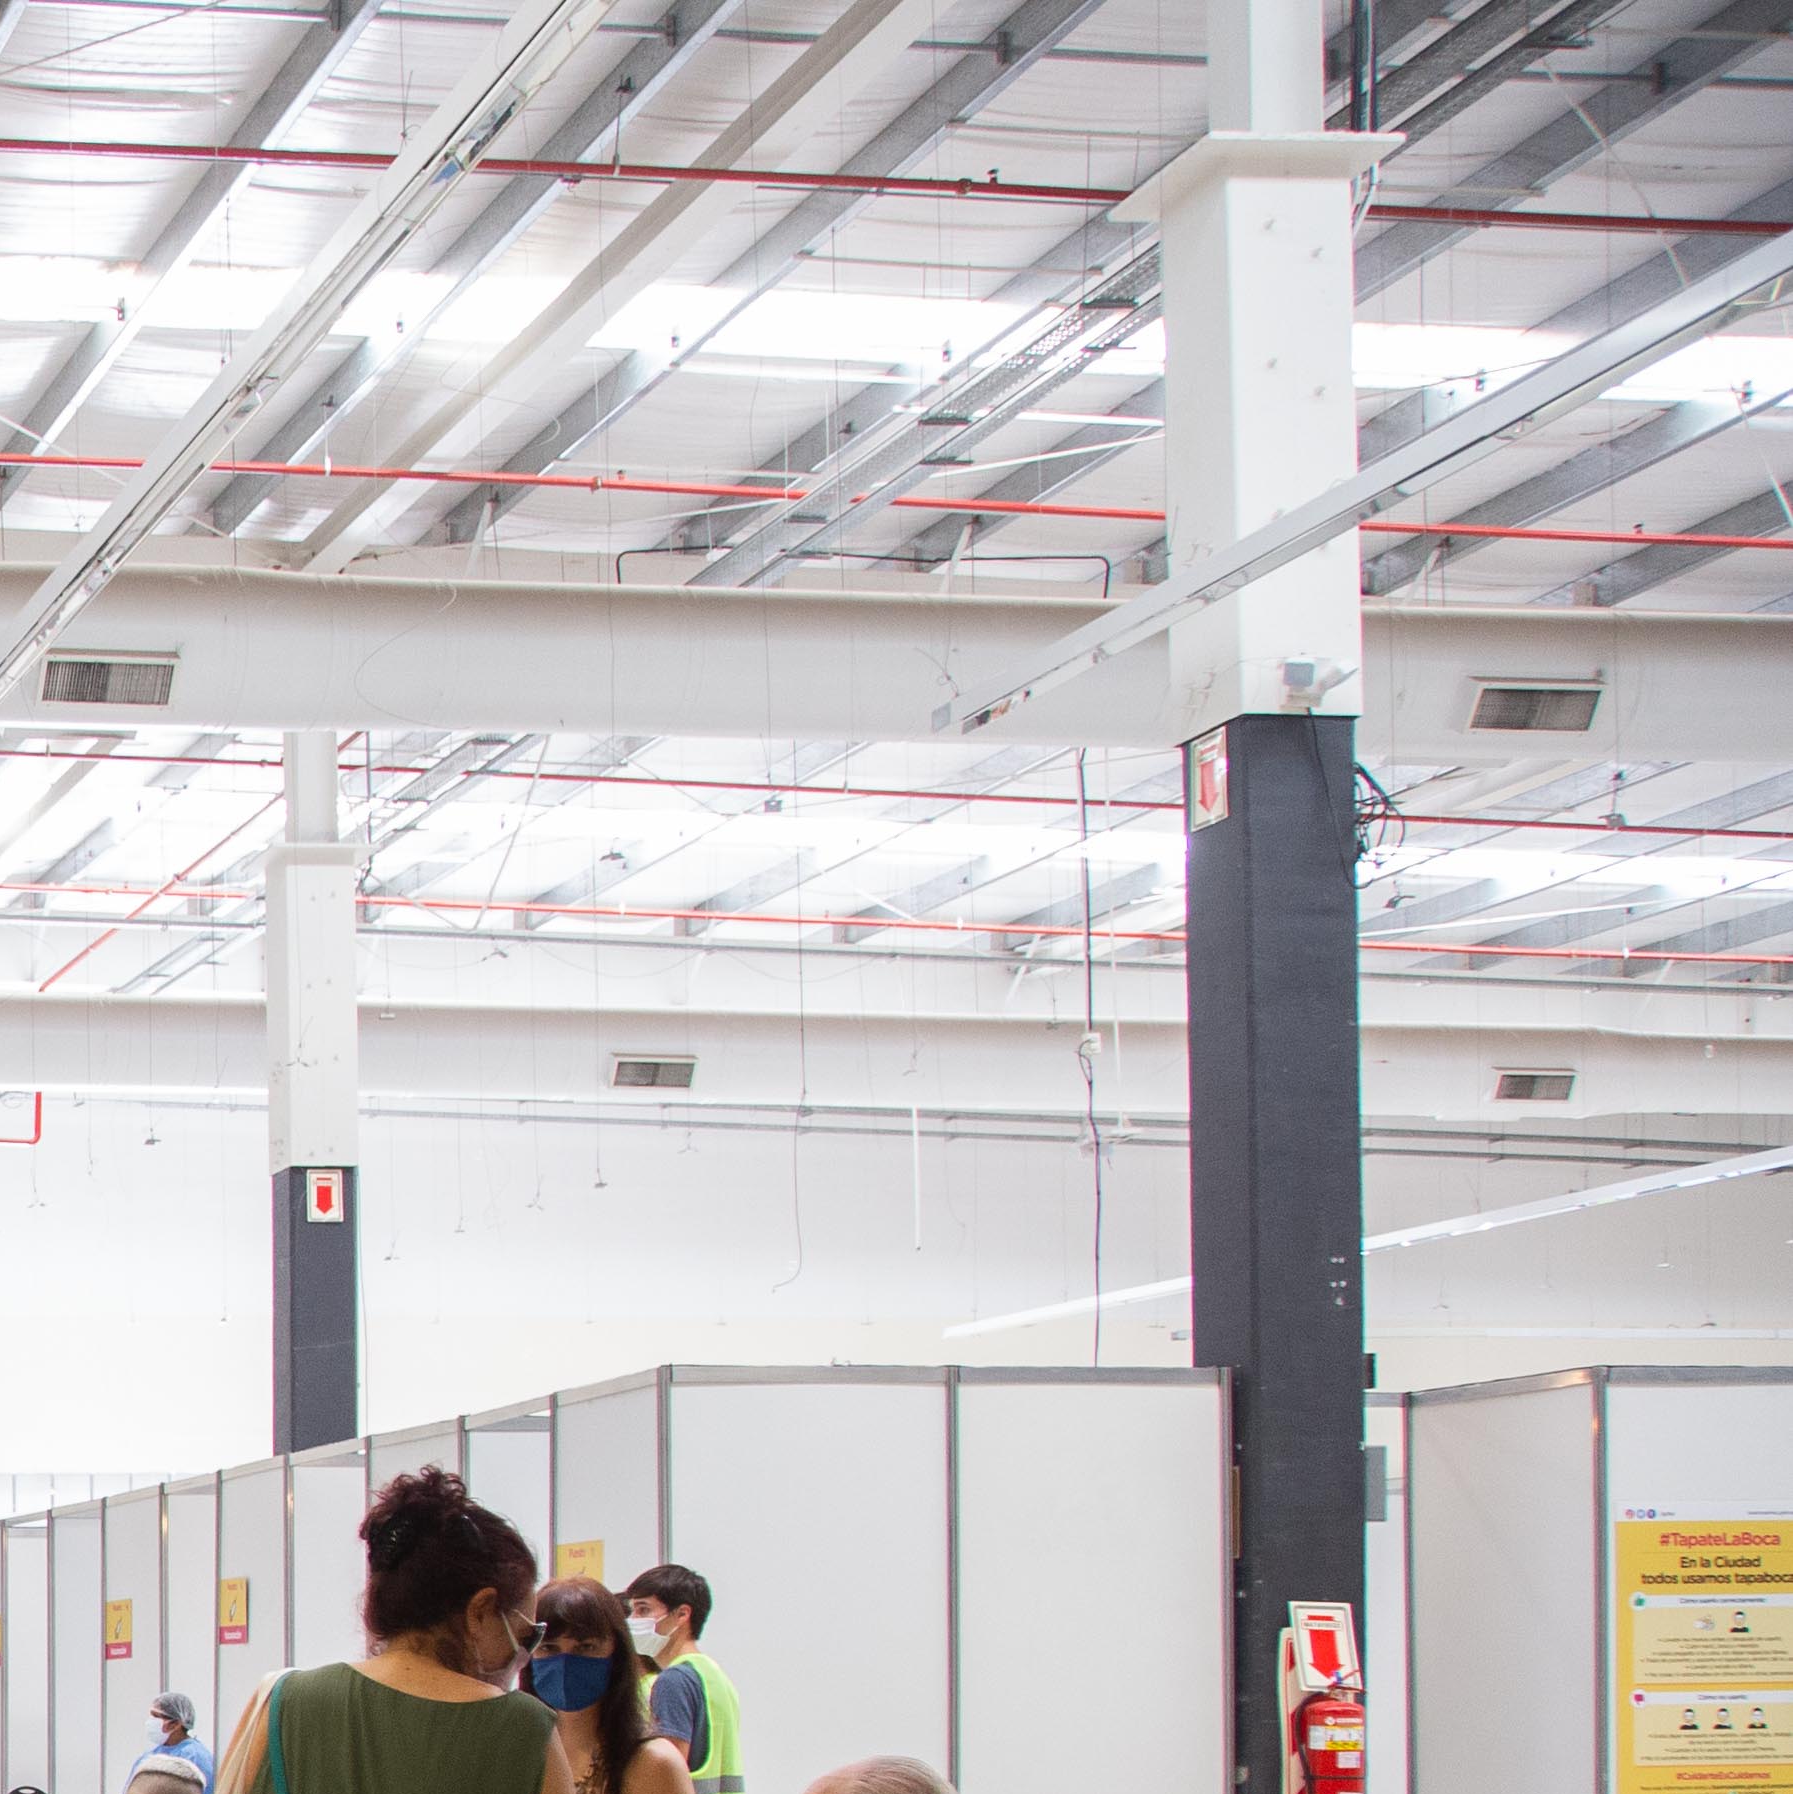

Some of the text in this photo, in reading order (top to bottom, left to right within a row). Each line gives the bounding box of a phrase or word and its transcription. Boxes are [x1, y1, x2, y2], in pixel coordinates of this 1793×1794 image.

[1660, 1532, 1781, 1548] #TapateLaBoca
[1680, 1556, 1761, 1568] En la Ciudad
[1642, 1574, 1679, 1585] todos
[1682, 1574, 1731, 1585] usamos
